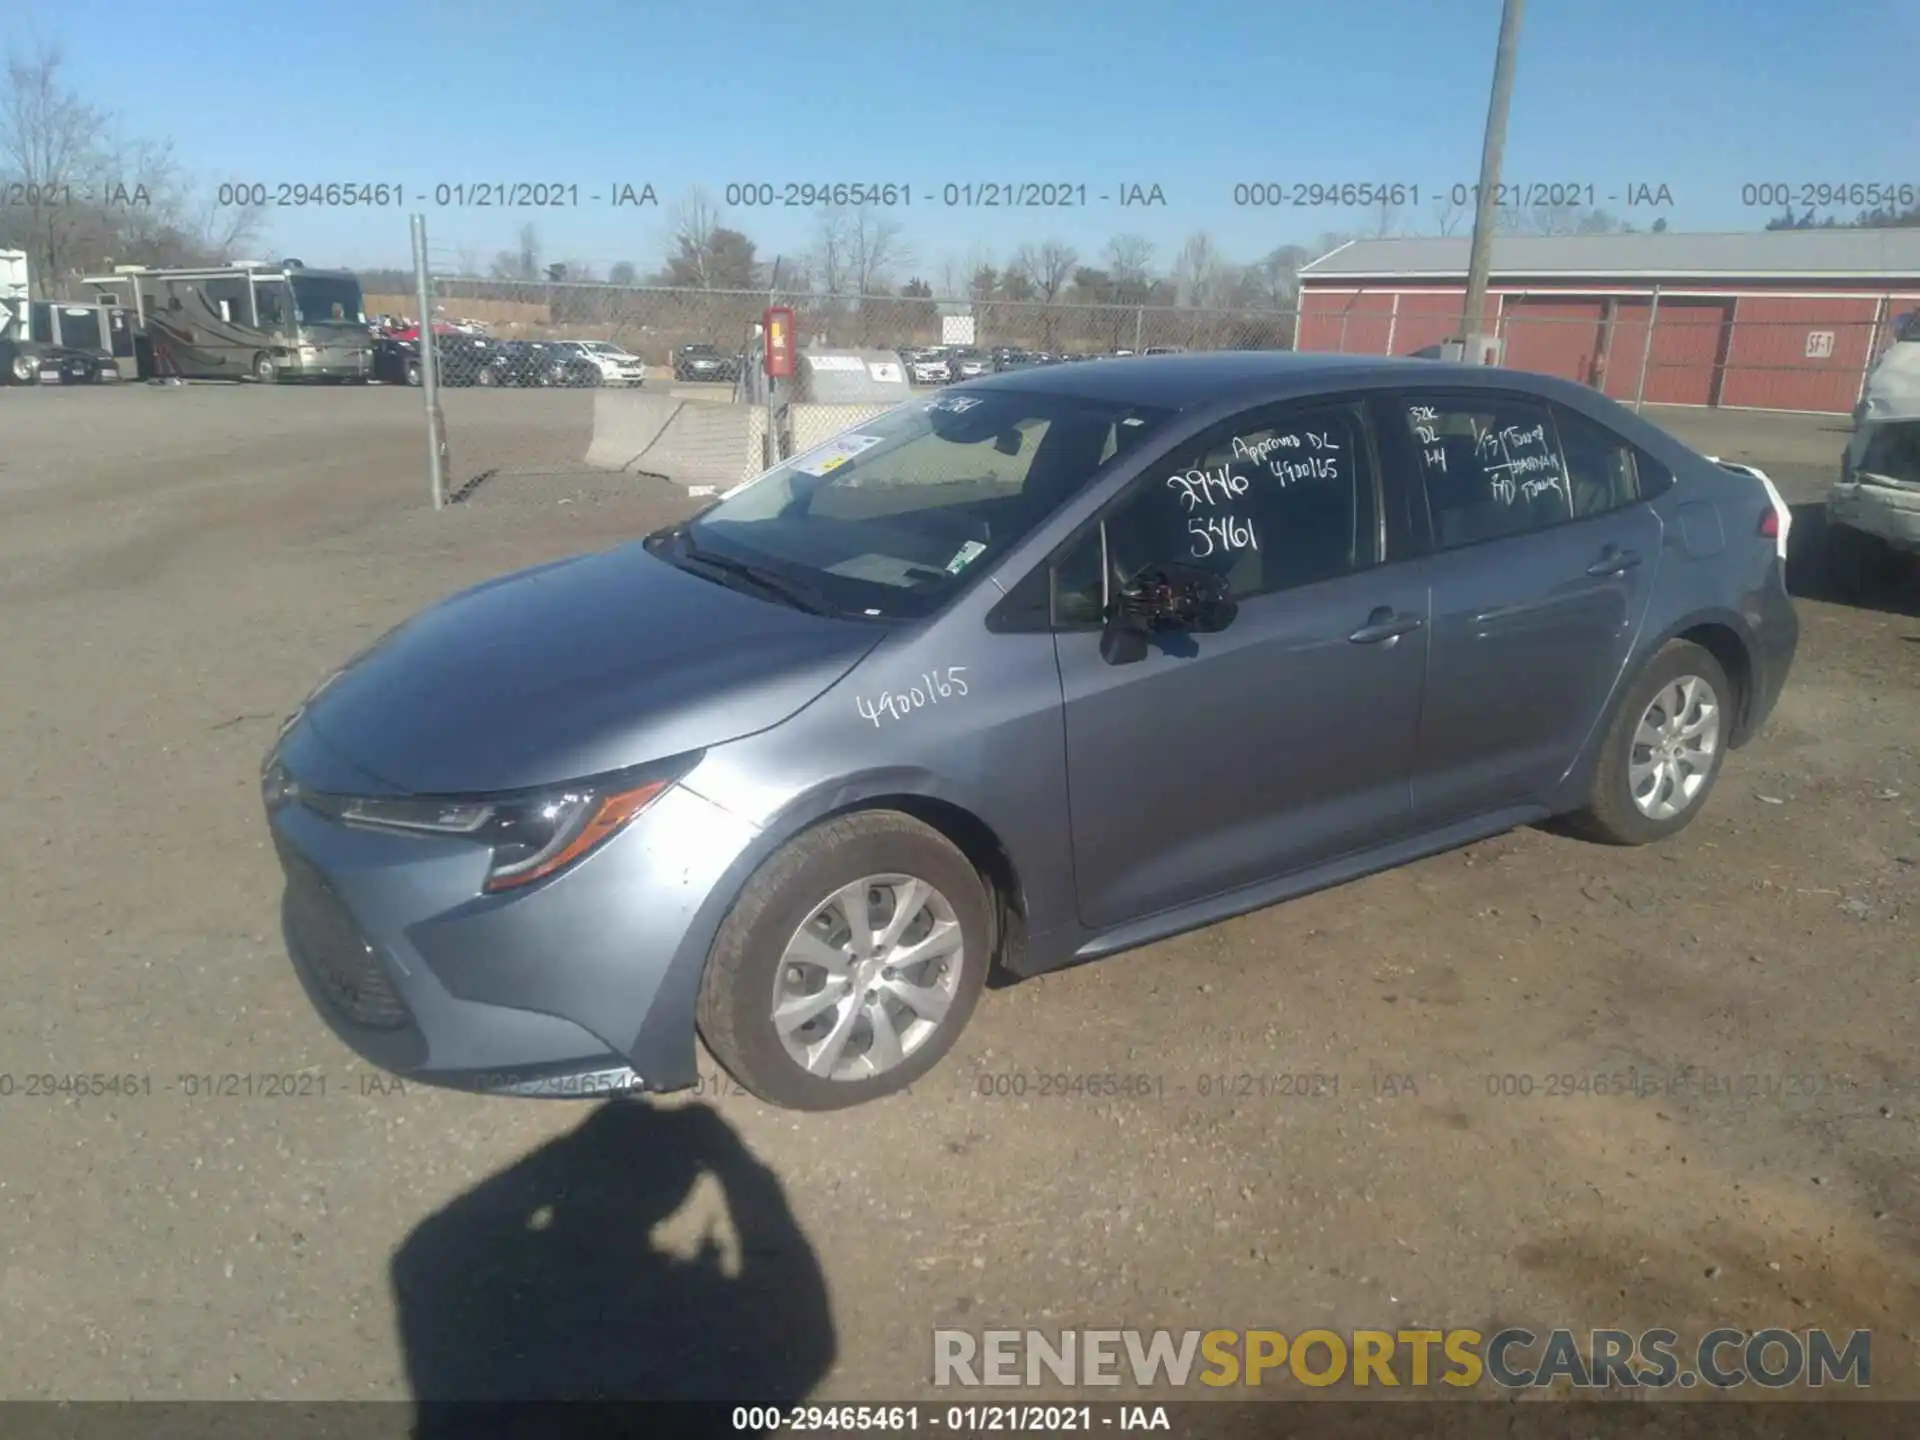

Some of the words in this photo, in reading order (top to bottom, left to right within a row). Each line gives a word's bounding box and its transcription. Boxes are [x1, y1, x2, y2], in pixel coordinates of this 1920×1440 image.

[1305, 431, 1340, 450] DL
[1166, 462, 1250, 512] 2946
[1269, 456, 1338, 488] 4900165
[1187, 515, 1258, 558] 5461
[855, 666, 969, 728] 4900165
